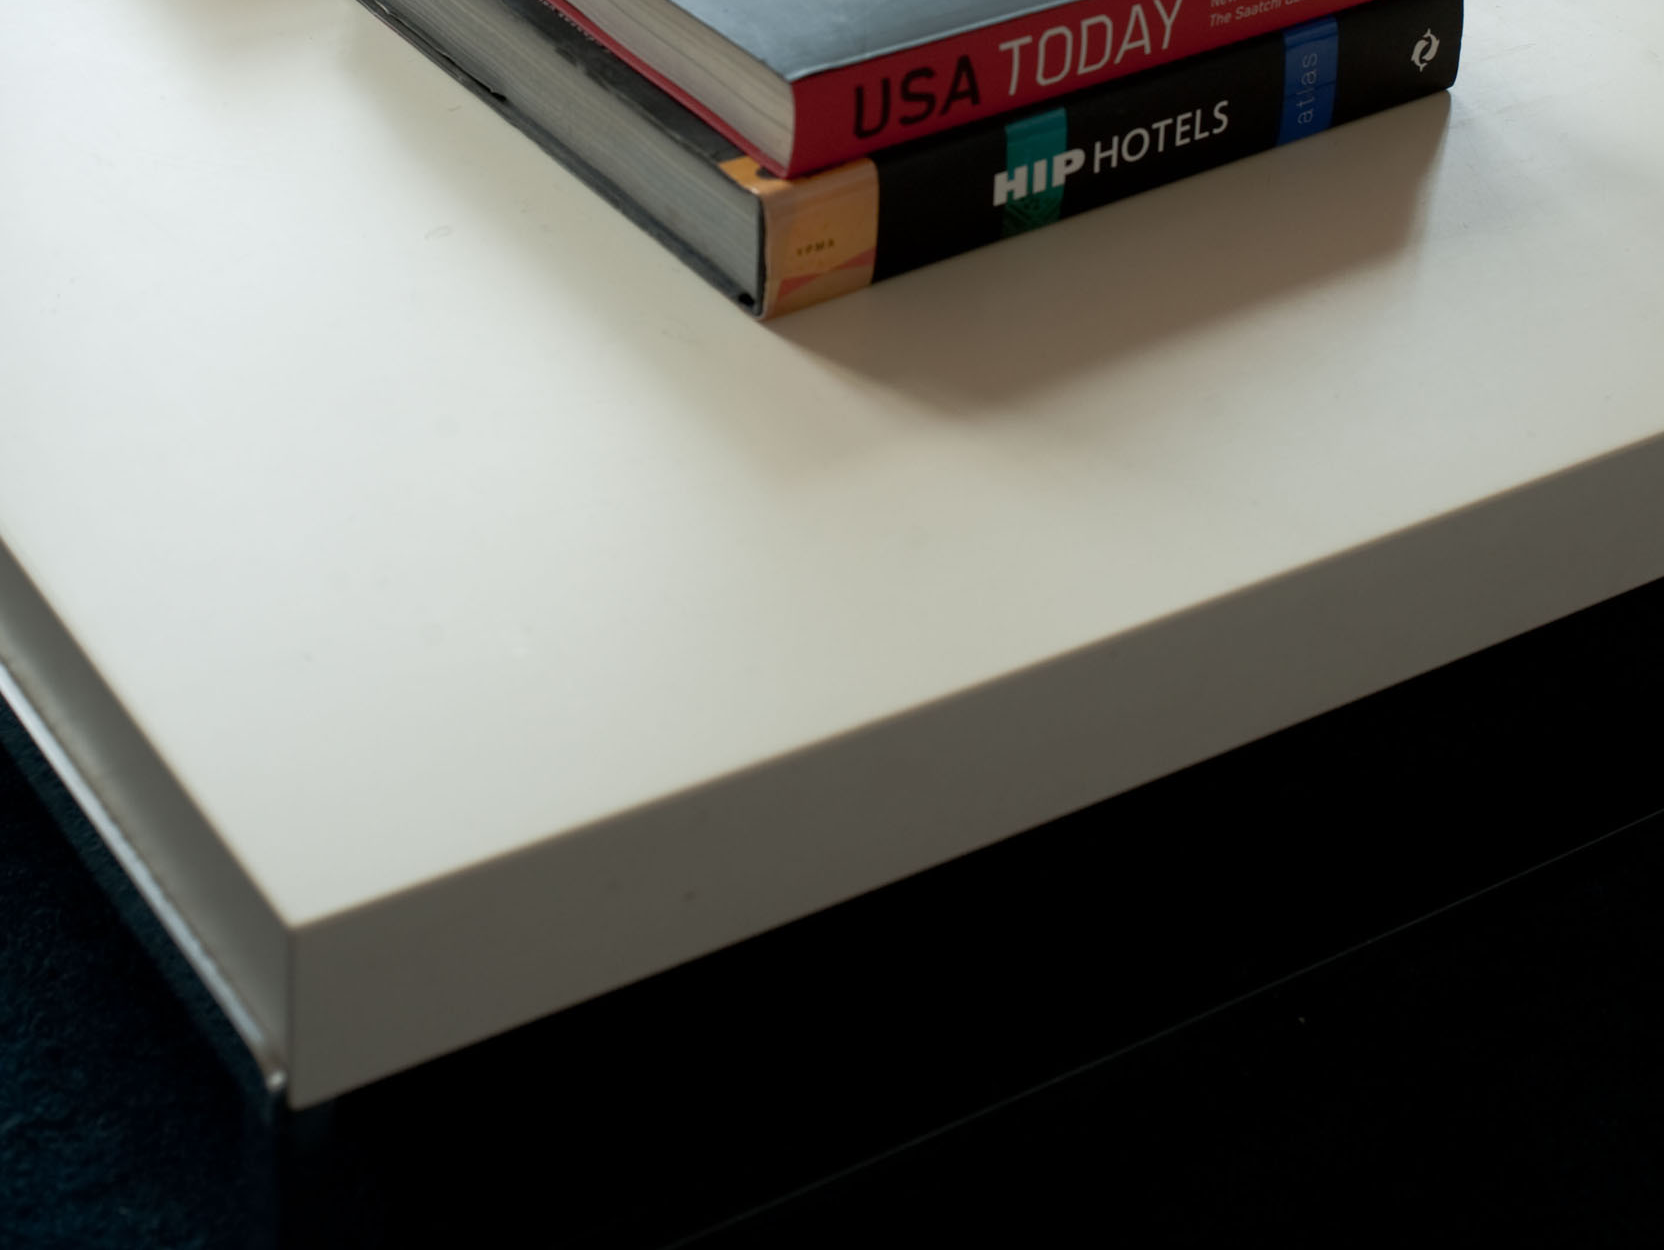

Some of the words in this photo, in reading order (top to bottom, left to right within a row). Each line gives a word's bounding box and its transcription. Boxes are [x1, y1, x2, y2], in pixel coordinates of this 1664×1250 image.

[1210, 12, 1231, 27] The
[852, 54, 981, 141] USA
[1296, 52, 1319, 124] atlas
[993, 148, 1087, 207] HIP
[1092, 99, 1231, 174] HOTELS
